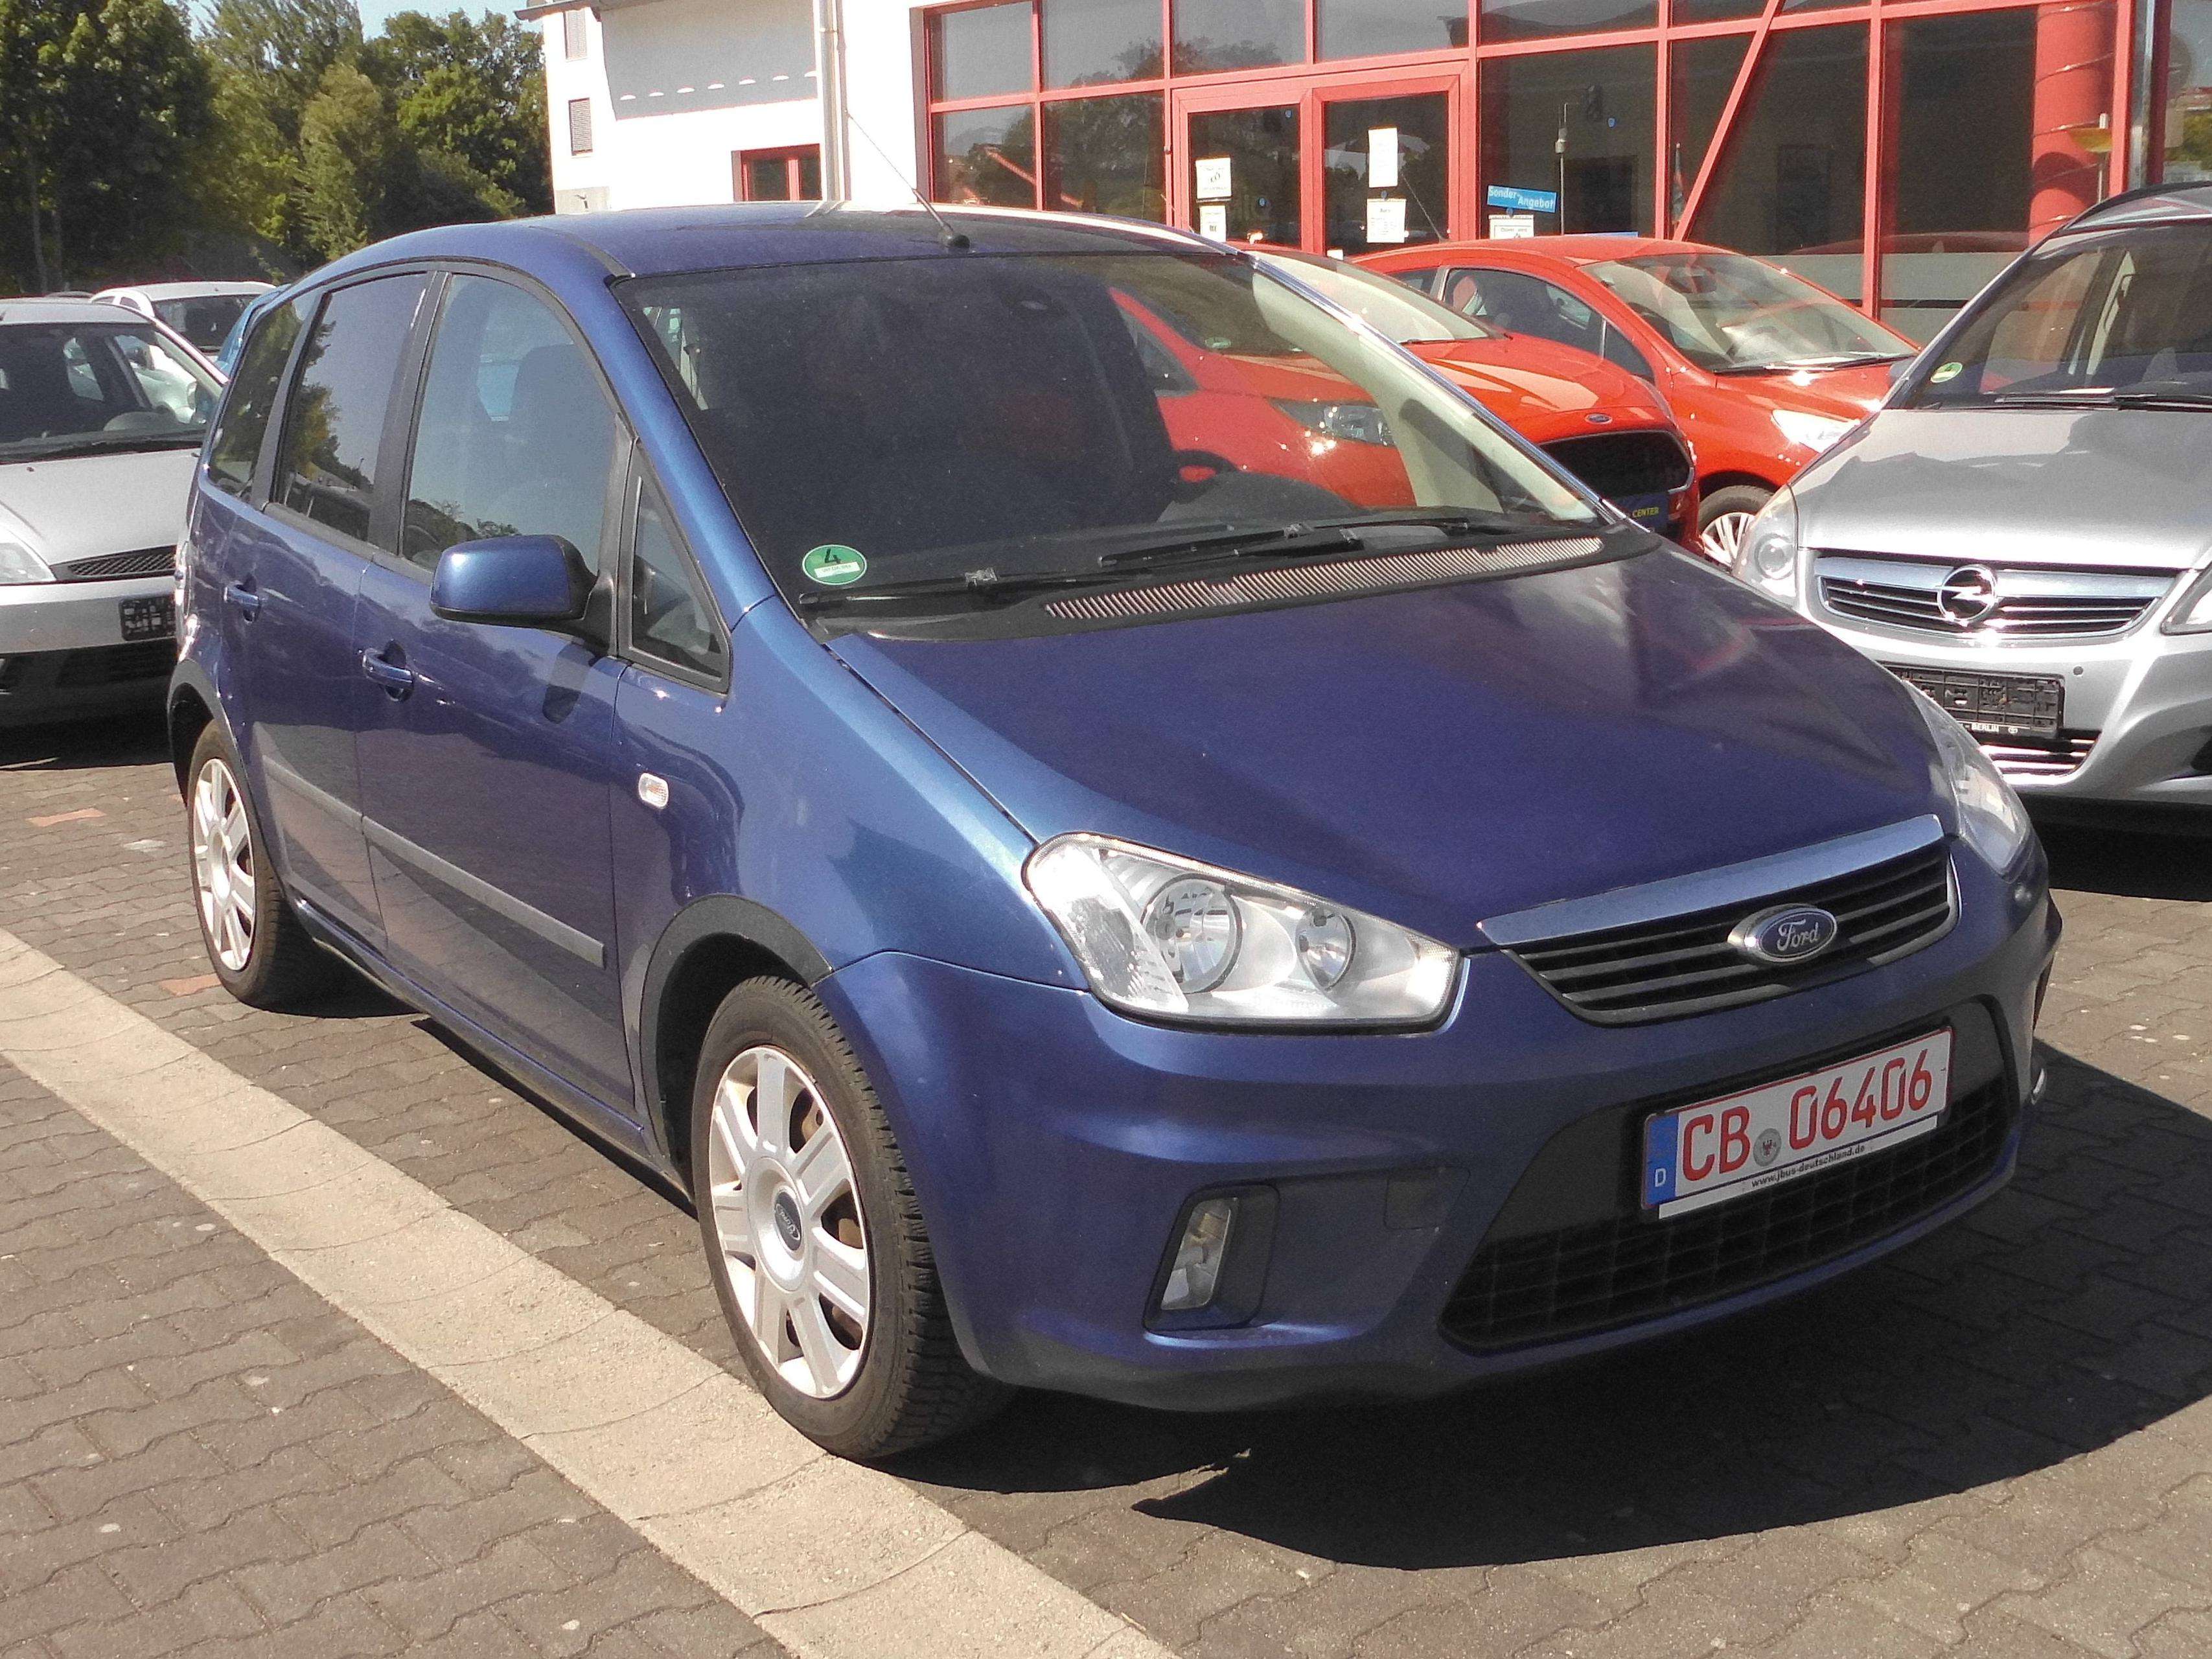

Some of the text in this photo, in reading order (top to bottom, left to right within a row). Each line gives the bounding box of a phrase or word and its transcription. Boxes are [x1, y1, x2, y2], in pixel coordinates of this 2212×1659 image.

[1517, 196, 1554, 210] Angebot
[1631, 507, 1660, 518] CENTER
[824, 548, 841, 564] 4
[1971, 723, 1999, 732] BERLIN
[1776, 918, 1819, 951] Ford
[1682, 1049, 1933, 1181] CB 06406
[1654, 1167, 1666, 1188] D
